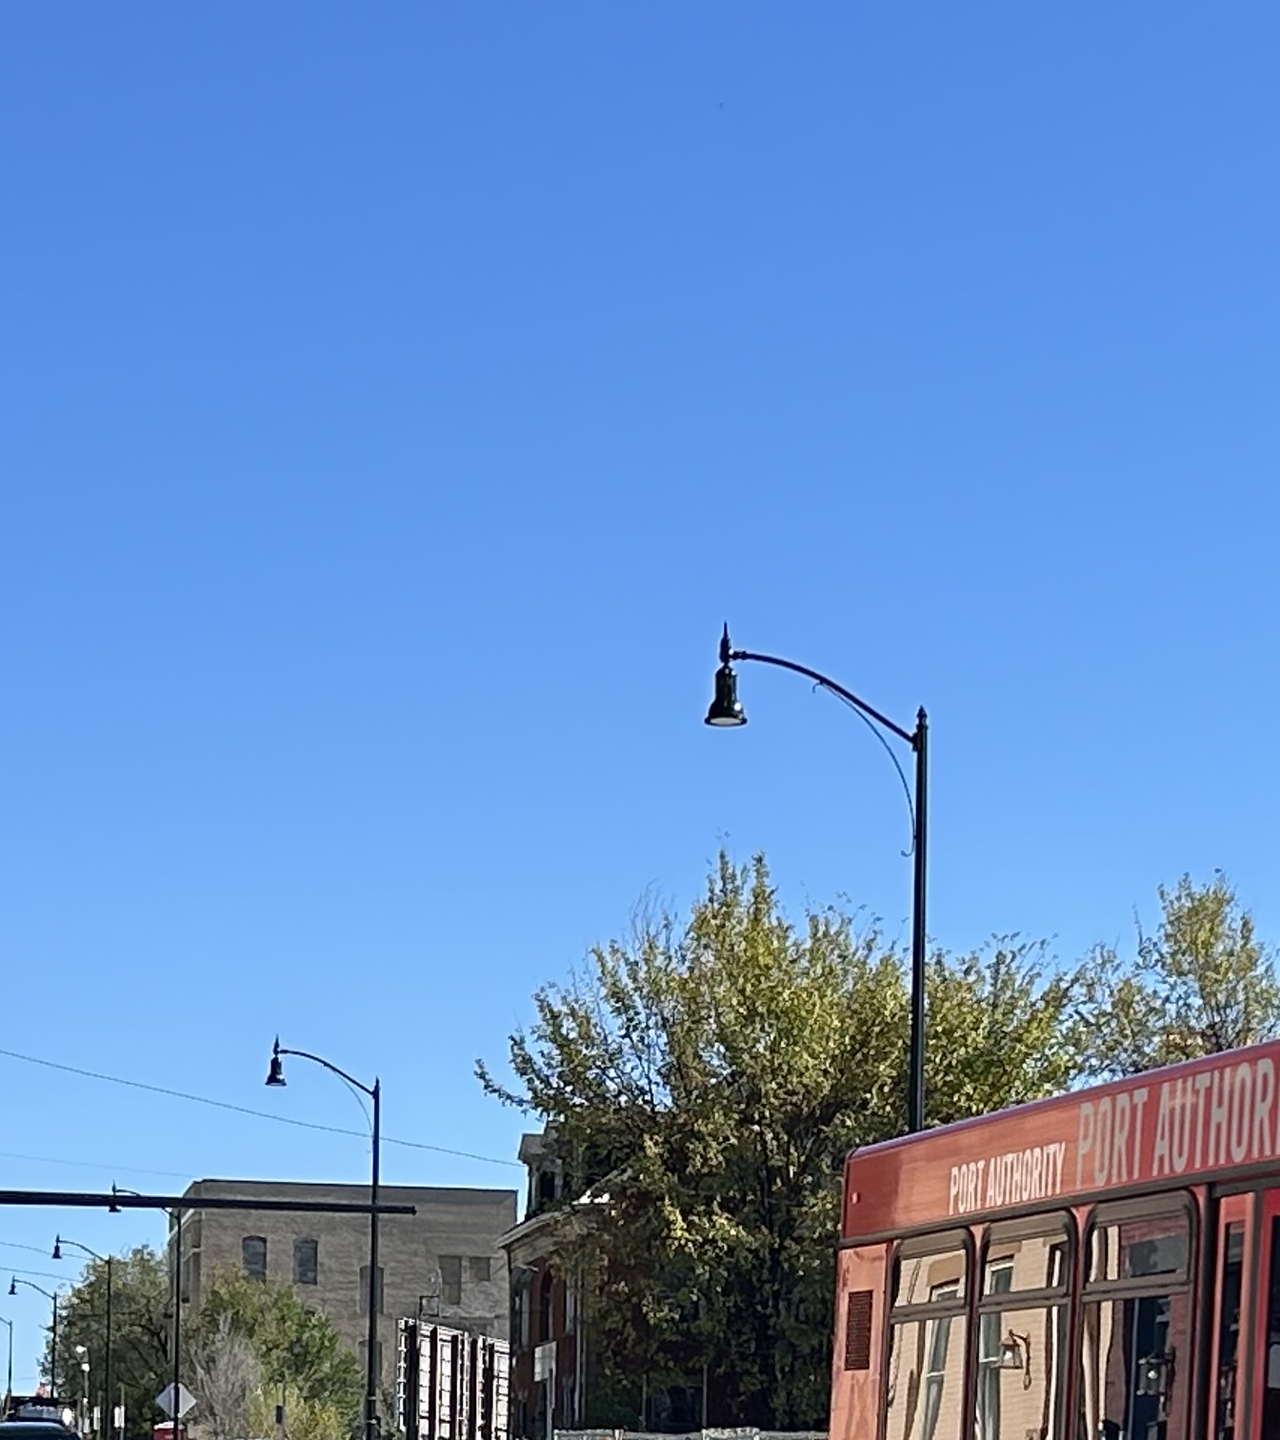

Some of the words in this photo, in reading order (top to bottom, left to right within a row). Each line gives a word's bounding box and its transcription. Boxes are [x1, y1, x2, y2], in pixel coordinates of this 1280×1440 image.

[949, 1159, 986, 1216] PORT
[985, 1141, 1066, 1208] AUTHORITY
[1077, 1087, 1148, 1188] PORT
